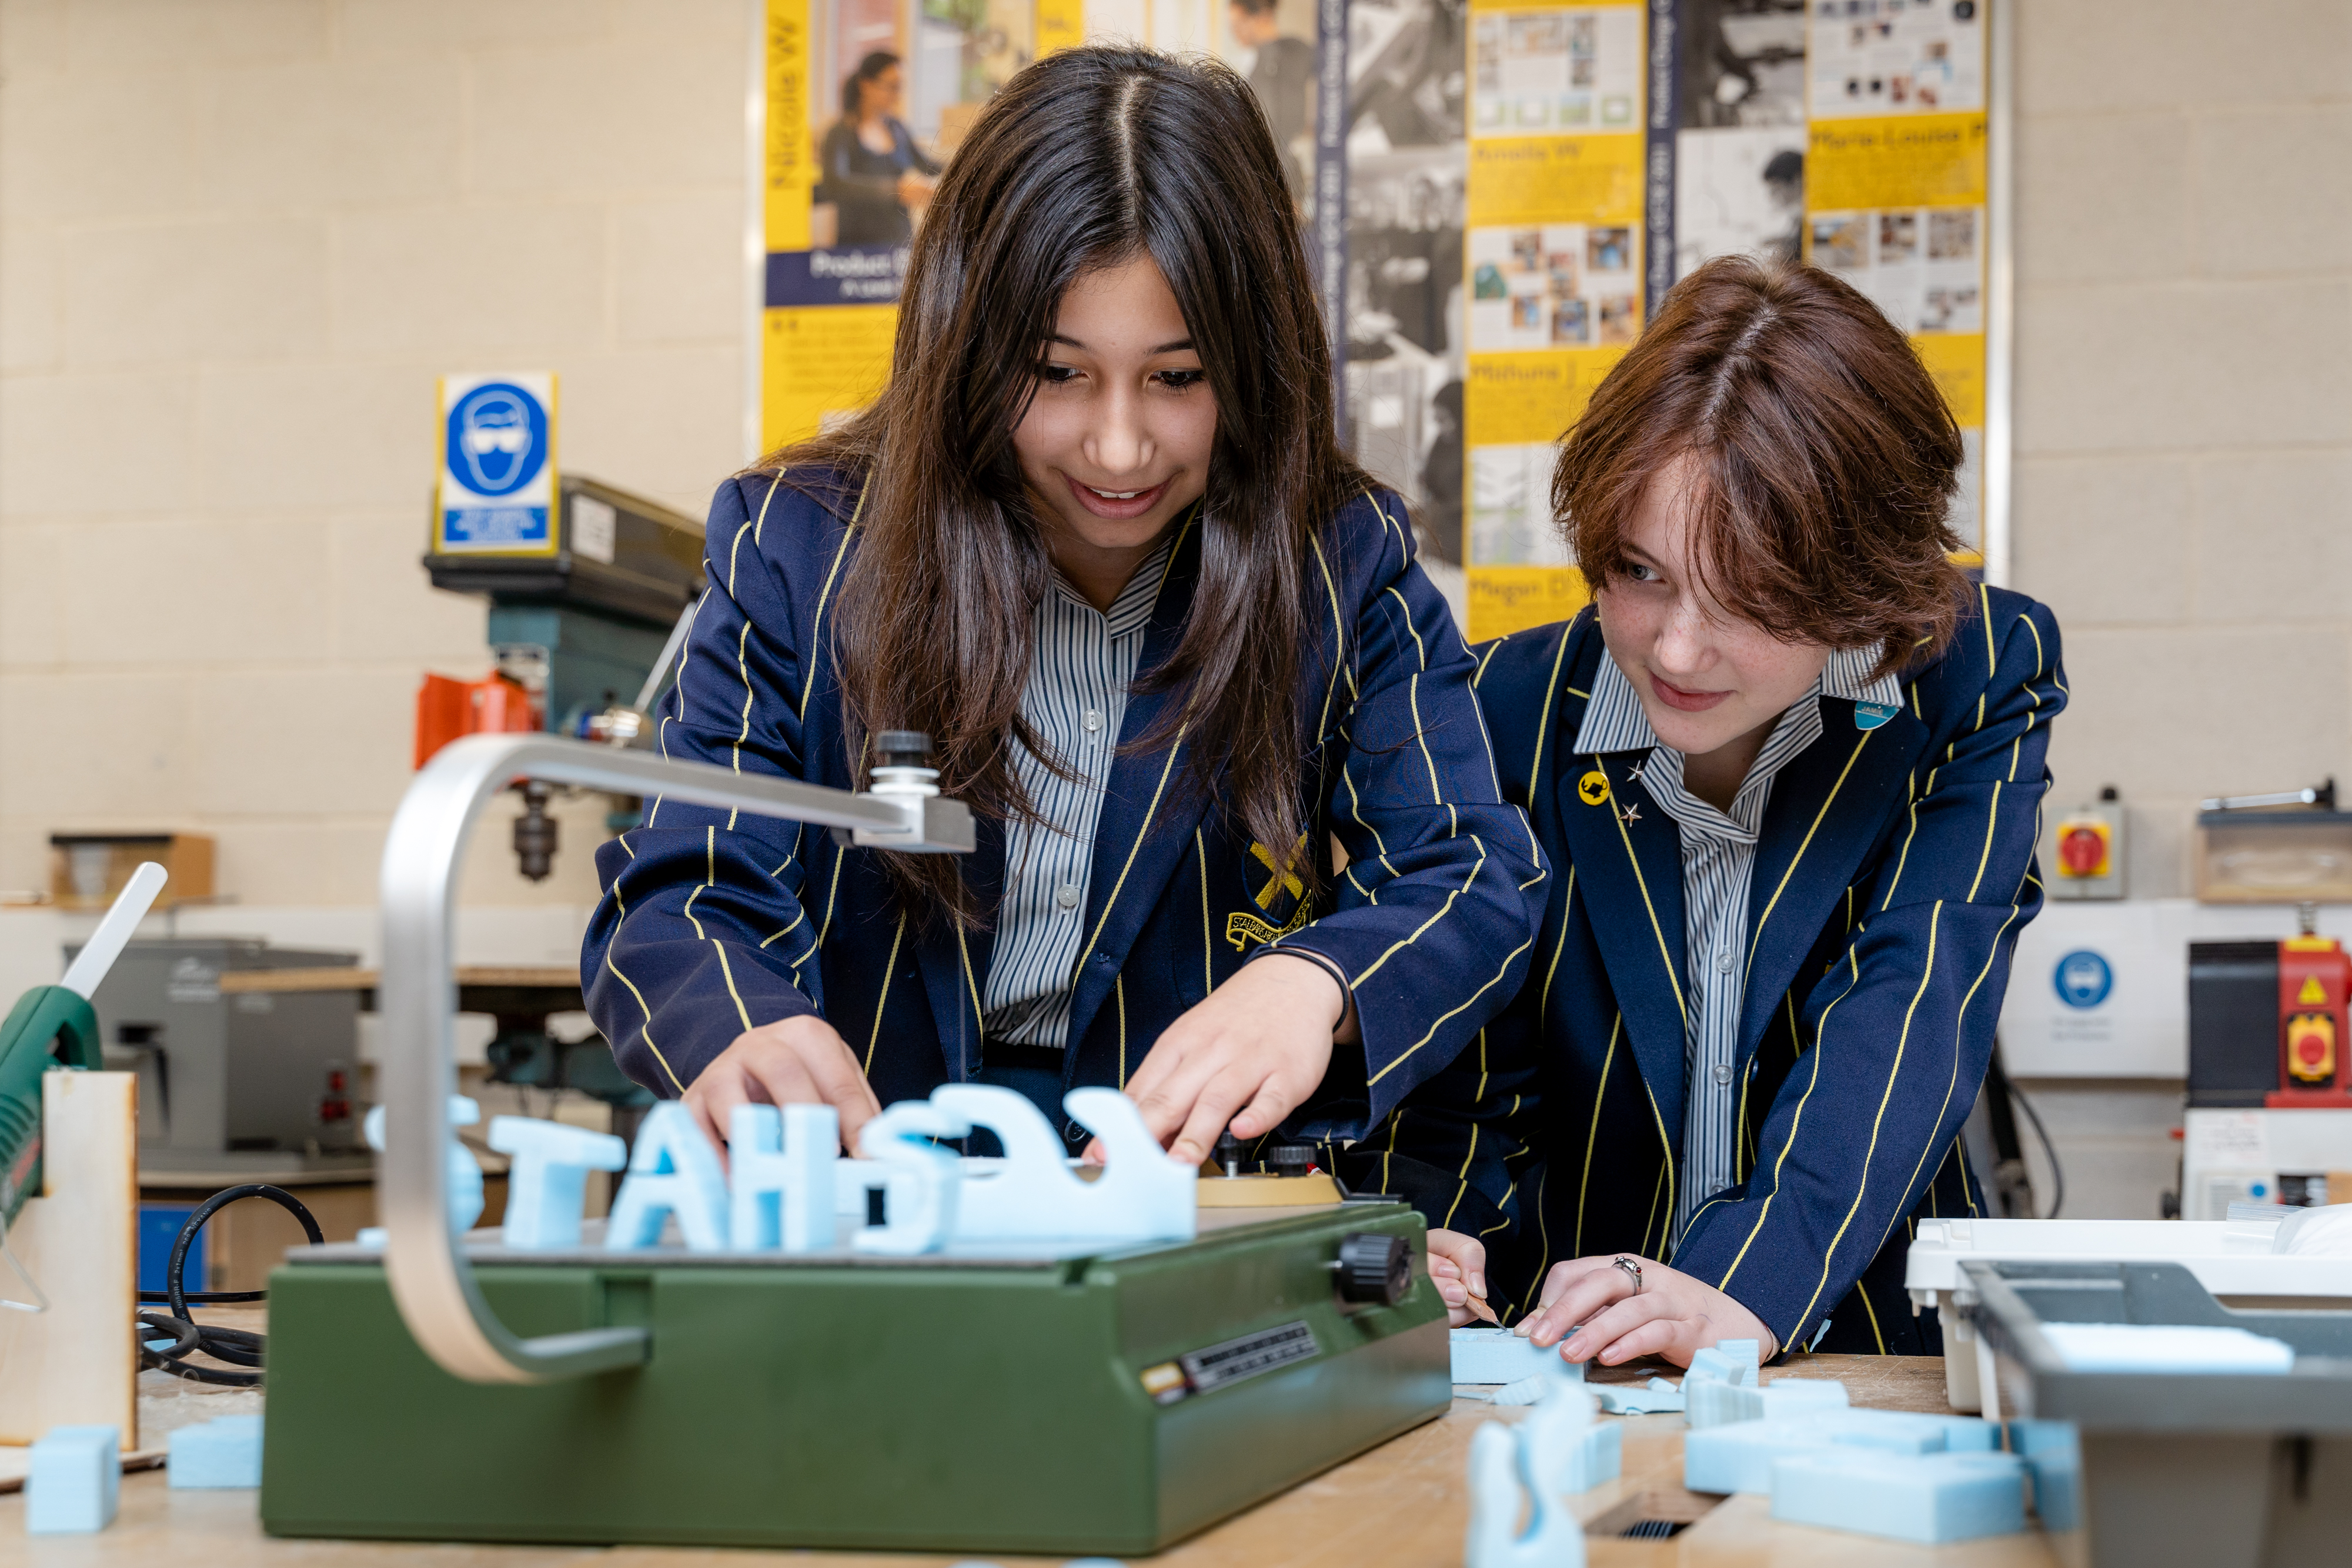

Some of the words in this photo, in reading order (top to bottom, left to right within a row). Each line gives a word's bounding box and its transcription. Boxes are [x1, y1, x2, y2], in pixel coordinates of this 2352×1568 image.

[768, 16, 799, 63] W
[770, 69, 801, 190] Nicole
[811, 251, 891, 277] Product
[191, 1207, 212, 1231] NEXANS
